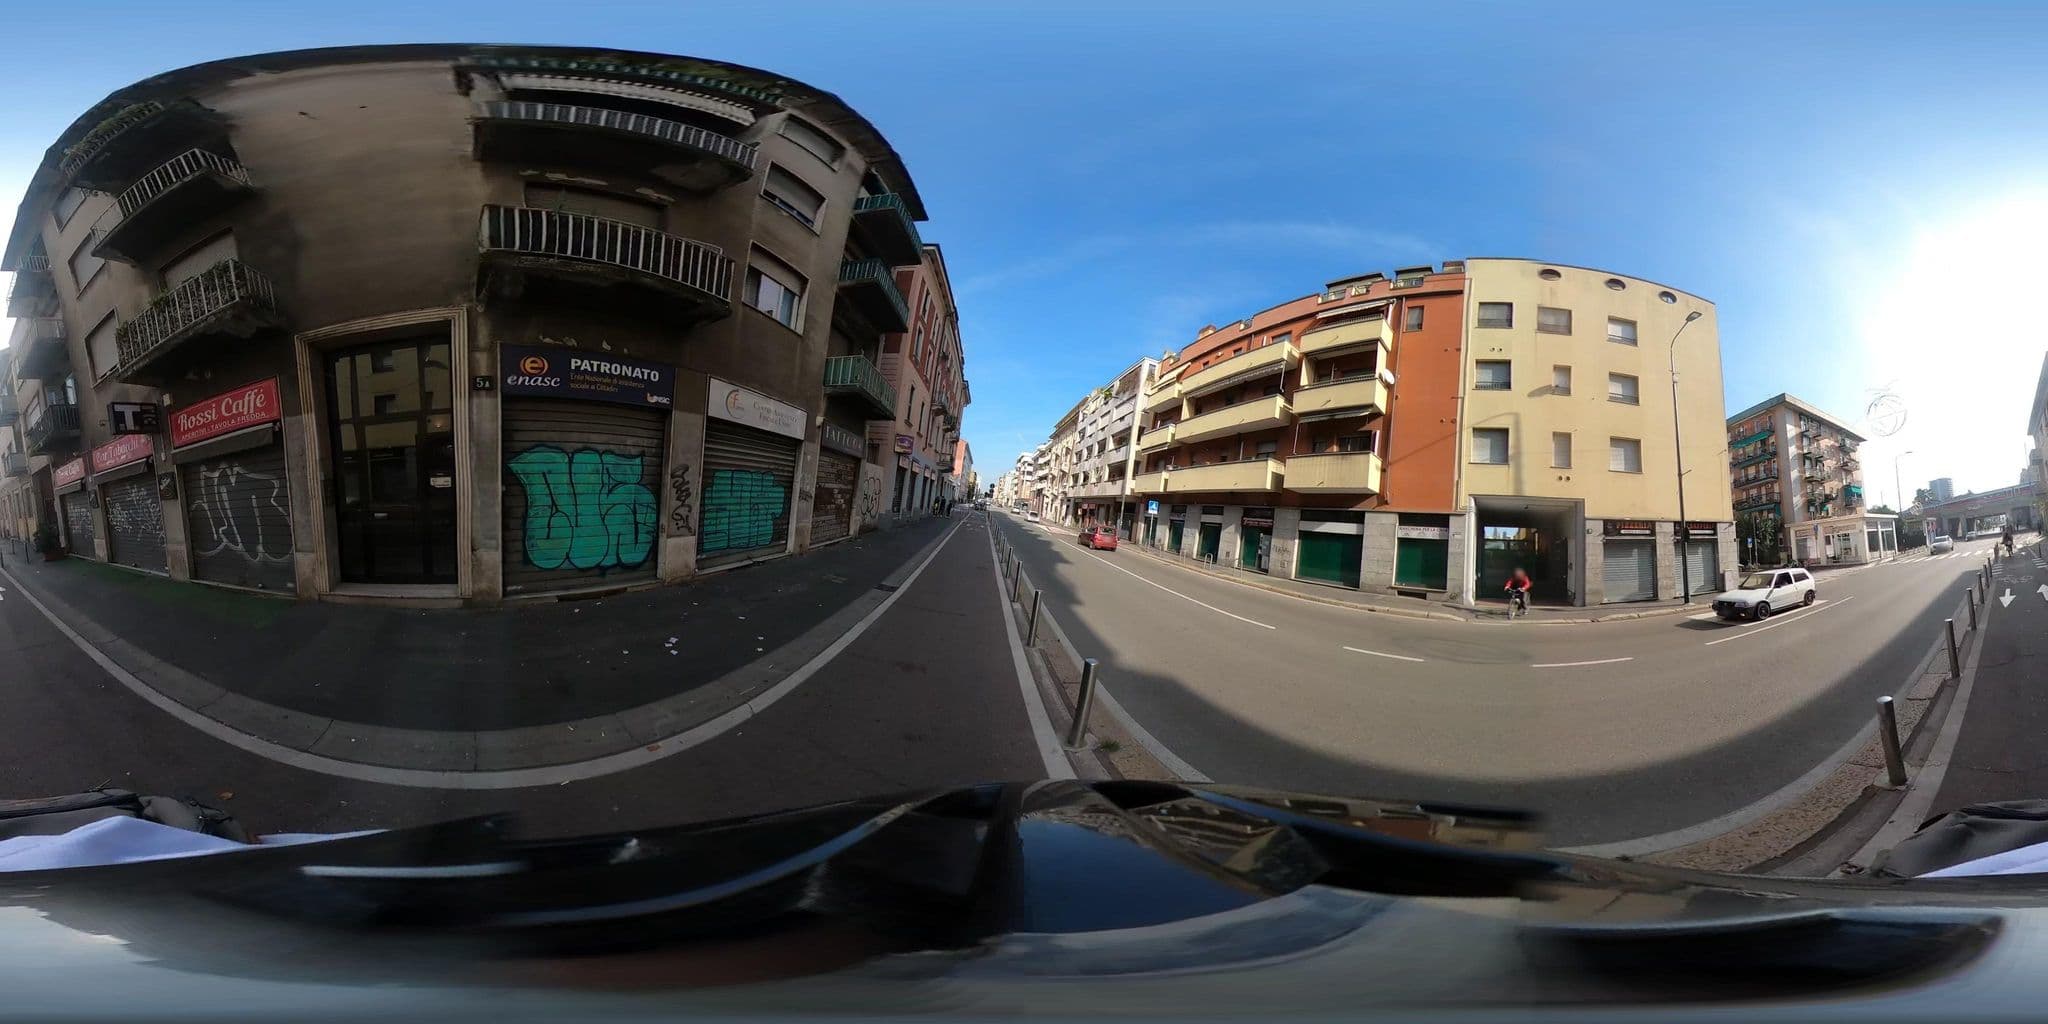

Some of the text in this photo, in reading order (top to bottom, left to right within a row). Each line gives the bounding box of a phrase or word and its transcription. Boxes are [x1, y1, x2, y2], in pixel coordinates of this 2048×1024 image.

[570, 358, 659, 382] PATRONATO
[506, 375, 561, 387] enasc
[178, 404, 219, 432] Rossi
[211, 418, 235, 430] TAVOLA
[237, 411, 266, 423] FREDDA
